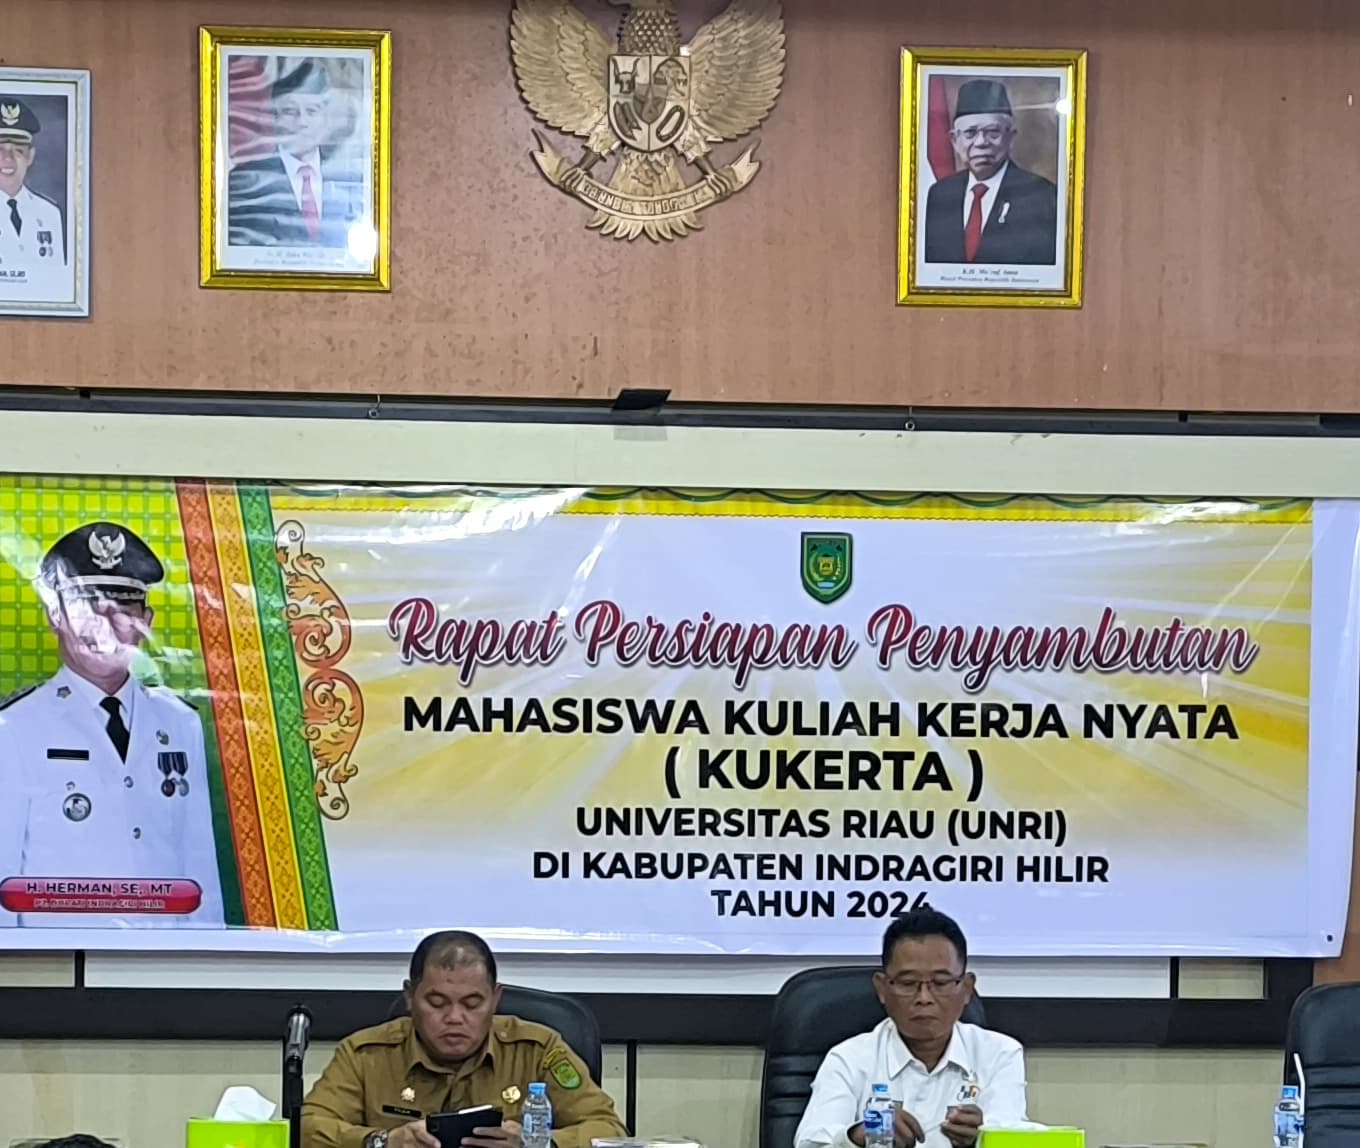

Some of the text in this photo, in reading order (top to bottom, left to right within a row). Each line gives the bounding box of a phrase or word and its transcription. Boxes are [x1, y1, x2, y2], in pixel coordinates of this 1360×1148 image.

[389, 597, 1258, 693] Rapat Persiapan Penyambutan
[403, 696, 1240, 740] MAHASISWA KULIAH KERJA NYATA
[576, 807, 1067, 847] UNIVERSITAS RIAU (UNRI)
[533, 851, 1110, 883] DI KABUPATEN INDRAGIRI HILIR
[26, 882, 41, 893] H.
[151, 884, 173, 894] MT
[710, 889, 835, 917] TAHUN
